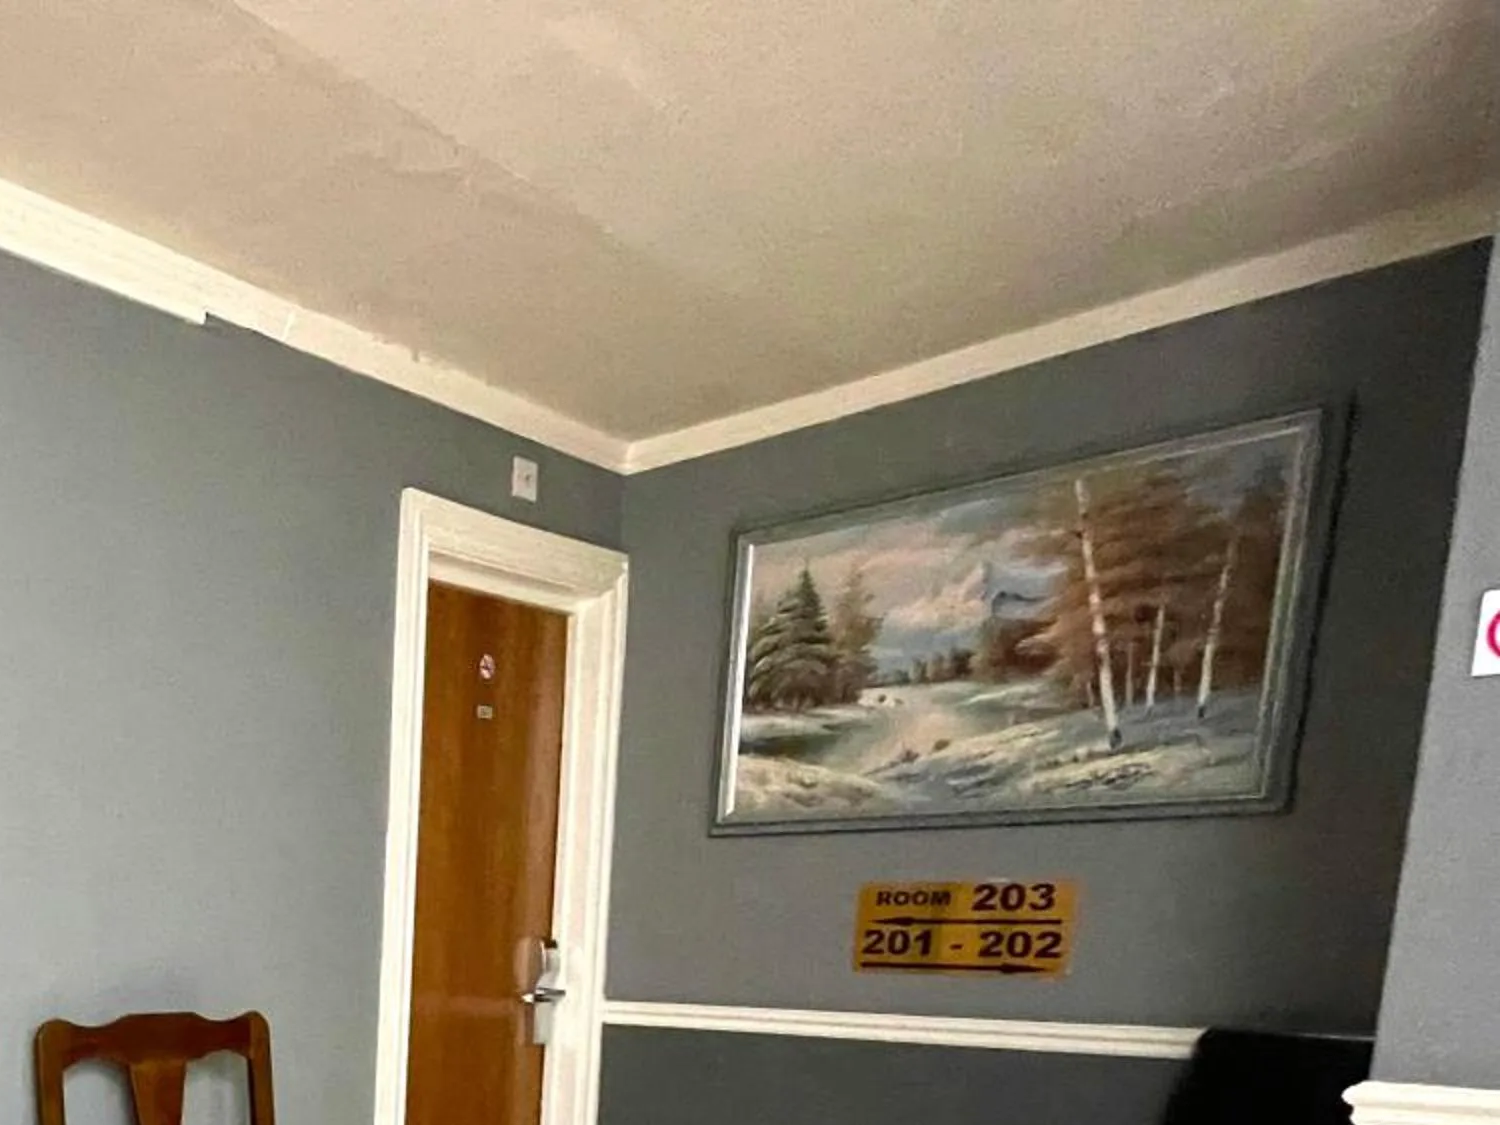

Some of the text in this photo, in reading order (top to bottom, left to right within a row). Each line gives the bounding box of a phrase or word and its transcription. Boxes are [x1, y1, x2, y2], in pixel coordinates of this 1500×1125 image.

[876, 882, 1057, 912] ROOM 203
[861, 929, 932, 956] 201
[978, 931, 1063, 958] 202
